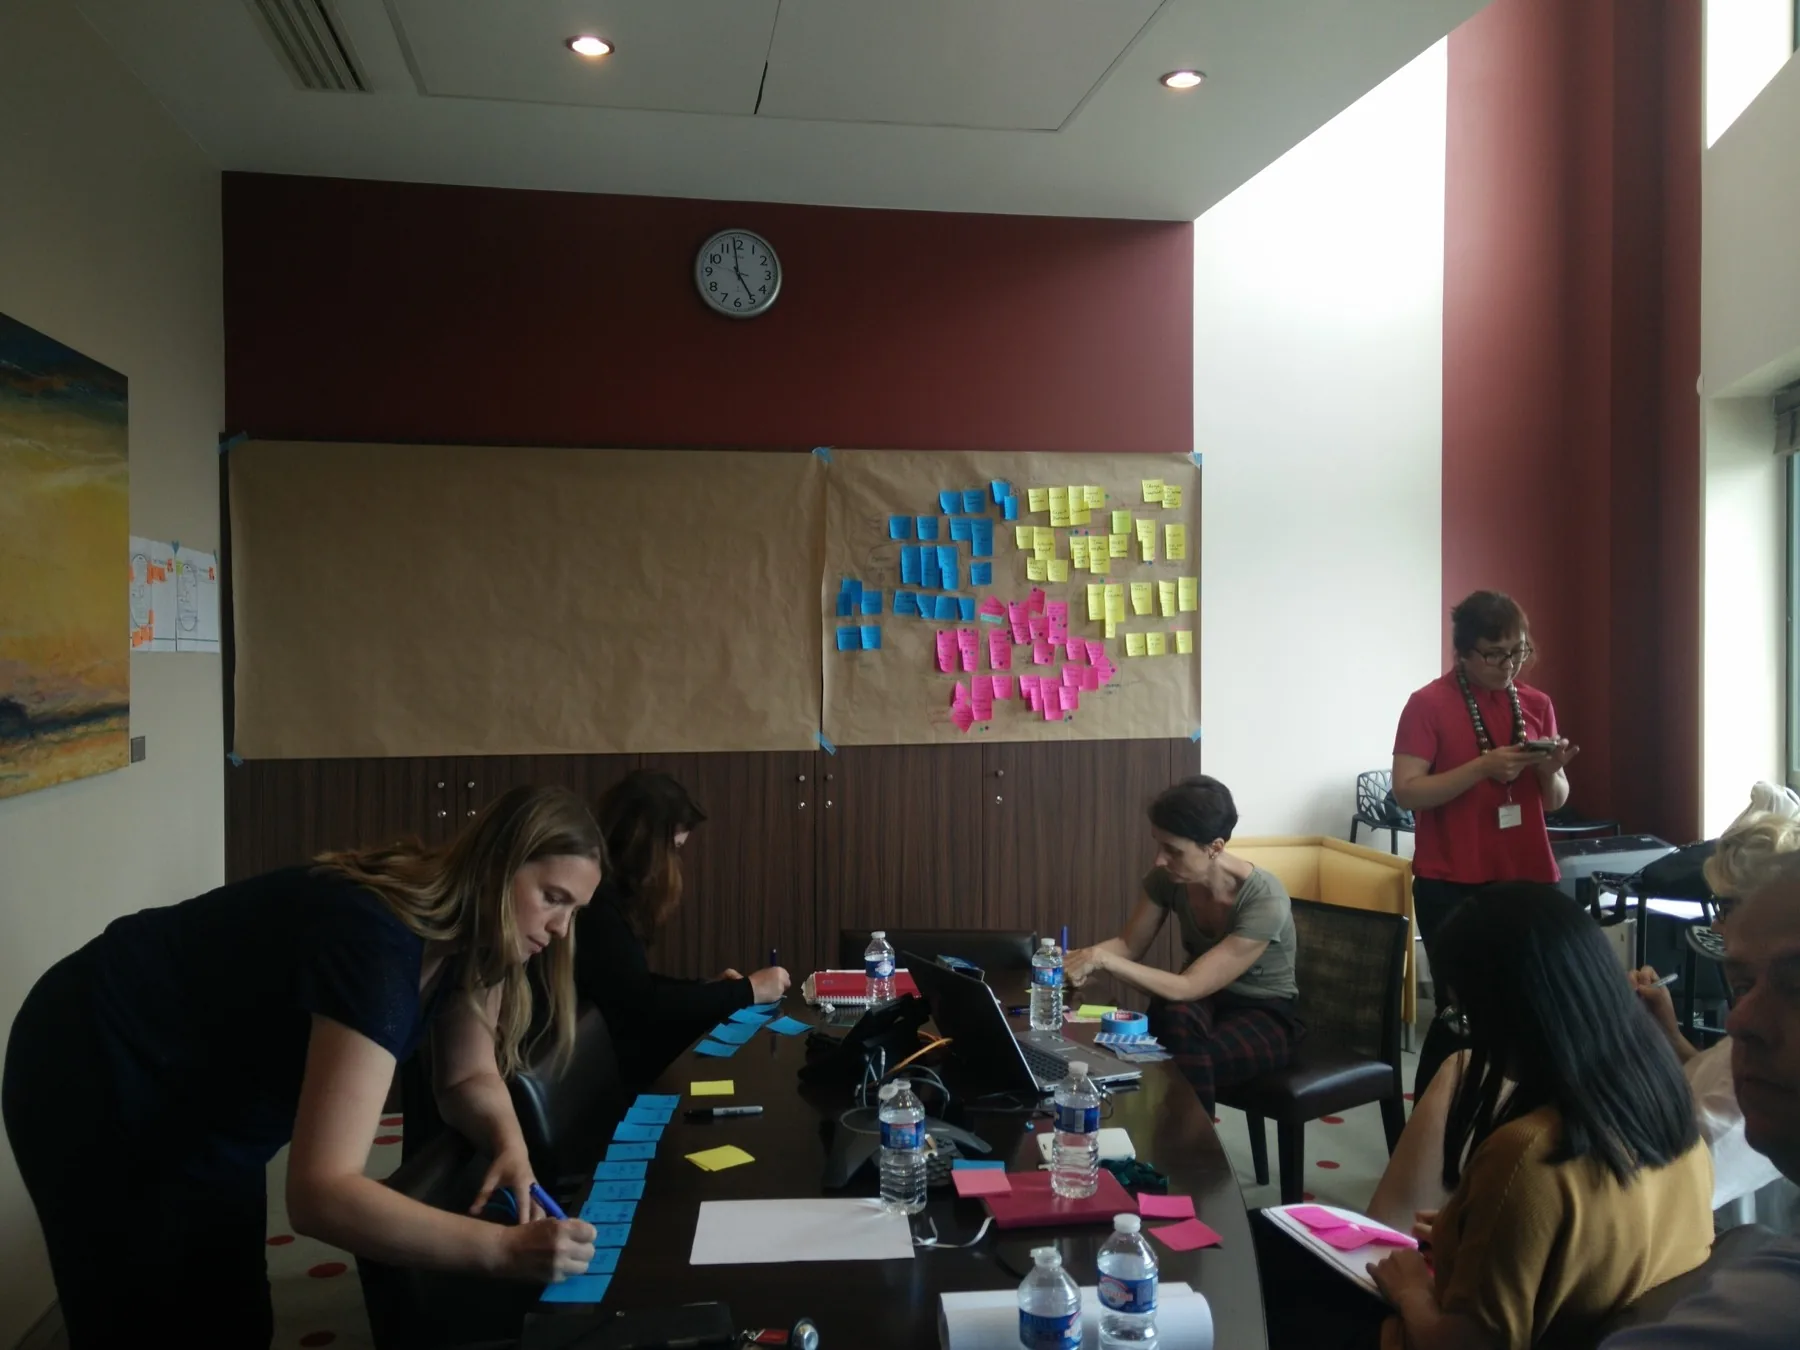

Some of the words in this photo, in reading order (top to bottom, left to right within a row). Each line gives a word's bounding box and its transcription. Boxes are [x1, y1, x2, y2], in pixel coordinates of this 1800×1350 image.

[721, 243, 729, 254] 11
[752, 245, 755, 255] 1
[710, 254, 721, 264] 10
[760, 256, 767, 266] 2
[705, 267, 713, 276] 9
[764, 271, 771, 280] 3
[709, 281, 718, 292] 8
[759, 284, 767, 294] 4
[720, 293, 728, 302] 7
[734, 298, 742, 307] 6
[749, 295, 756, 304] 5
